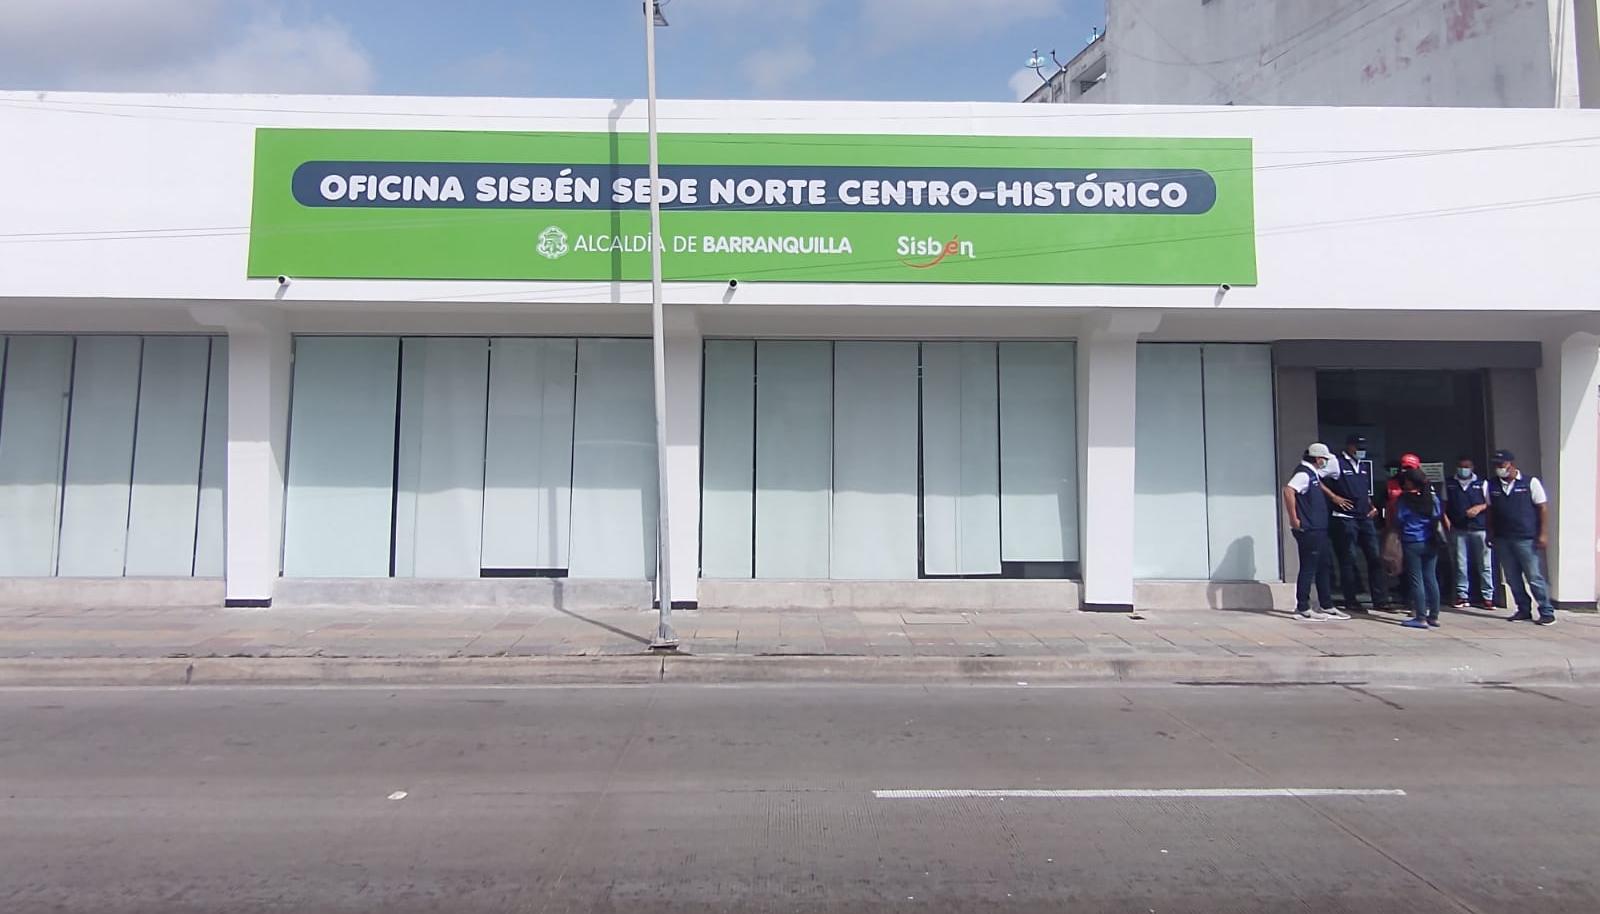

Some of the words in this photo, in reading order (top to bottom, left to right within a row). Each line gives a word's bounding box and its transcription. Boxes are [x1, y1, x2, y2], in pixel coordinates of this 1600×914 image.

[320, 174, 465, 202] OFICINA
[476, 168, 600, 203] SISBÉN
[612, 178, 698, 204] SEDE
[709, 178, 826, 205] NORTE
[838, 172, 1188, 208] CENTRO-HISTÓRICO
[673, 235, 697, 253] DE
[702, 235, 853, 256] BARRANQUILLA
[896, 234, 977, 260] Sisbén
